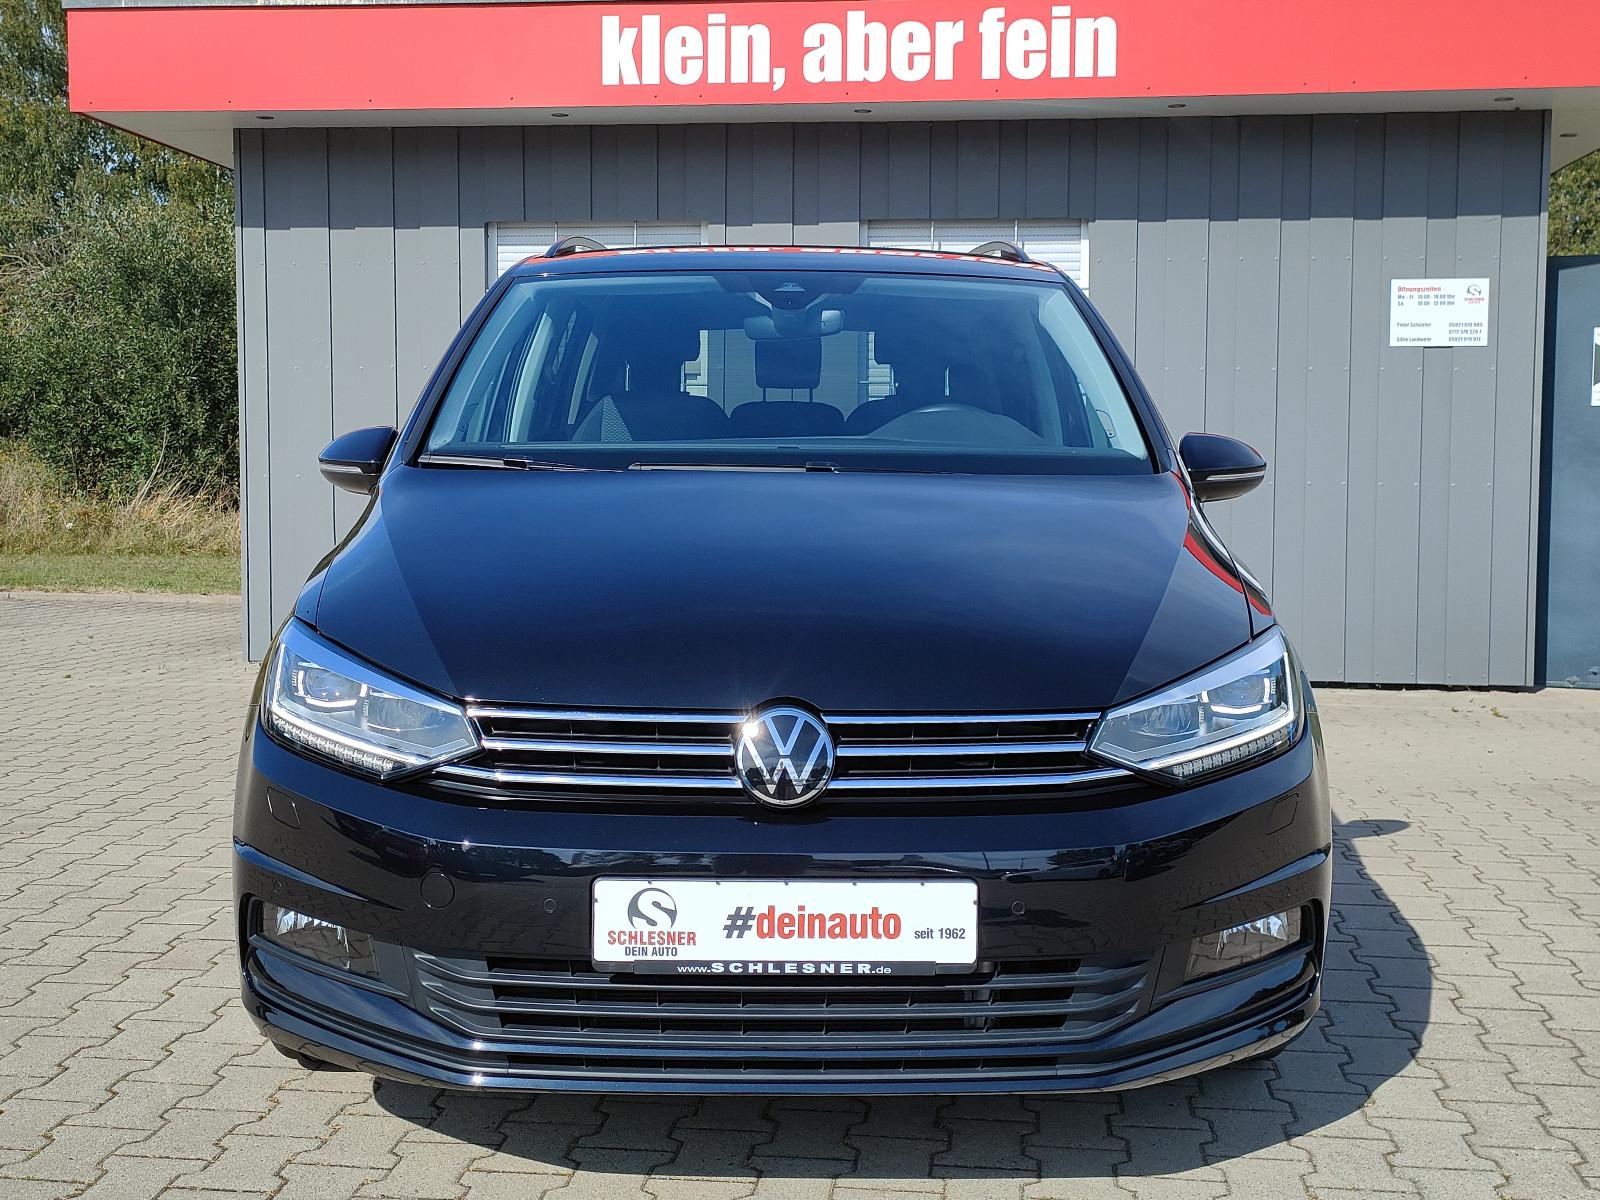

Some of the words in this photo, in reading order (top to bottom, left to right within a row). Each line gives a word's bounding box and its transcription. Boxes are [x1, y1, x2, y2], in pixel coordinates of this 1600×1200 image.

[601, 12, 786, 91] klein,
[802, 10, 965, 84] aber
[979, 5, 1118, 80] fein
[723, 905, 901, 940] #deinauto
[607, 930, 697, 946] SCHLESNER
[914, 928, 934, 940] seit
[938, 928, 966, 940] 1962
[624, 946, 648, 957] DEIN
[651, 946, 678, 957] AUTO
[677, 962, 892, 975] www.SCHLESNER.de
